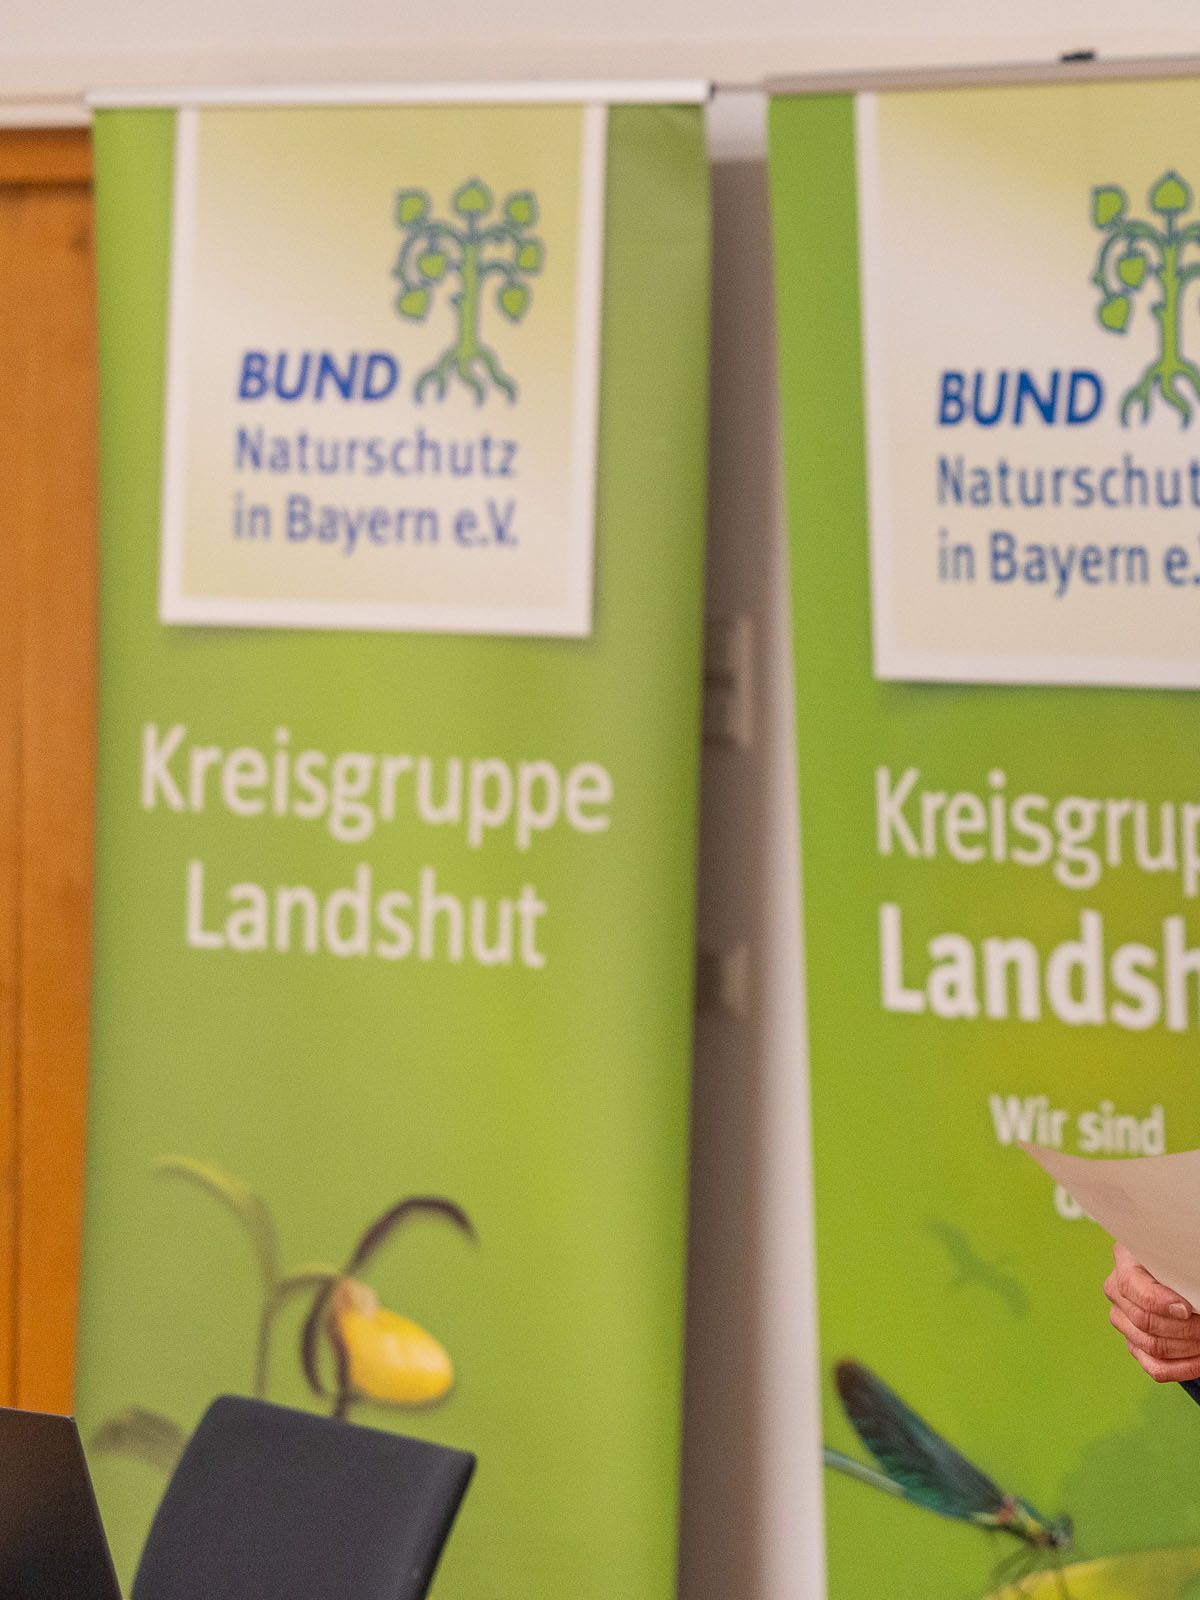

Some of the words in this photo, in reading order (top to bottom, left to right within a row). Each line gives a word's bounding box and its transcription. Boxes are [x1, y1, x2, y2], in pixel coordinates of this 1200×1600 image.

[236, 350, 400, 402] BUND
[937, 368, 1105, 428] BUND
[234, 426, 519, 478] Naturschutz
[234, 492, 272, 541] in
[285, 494, 440, 556] Bayern
[454, 500, 519, 548] e.V.
[938, 529, 975, 583] in
[990, 530, 1149, 597] Bayern
[140, 722, 614, 850] Kreisgruppe
[185, 859, 547, 968] Landshut
[991, 1095, 1067, 1147] Wir
[1077, 1102, 1164, 1156] sind
